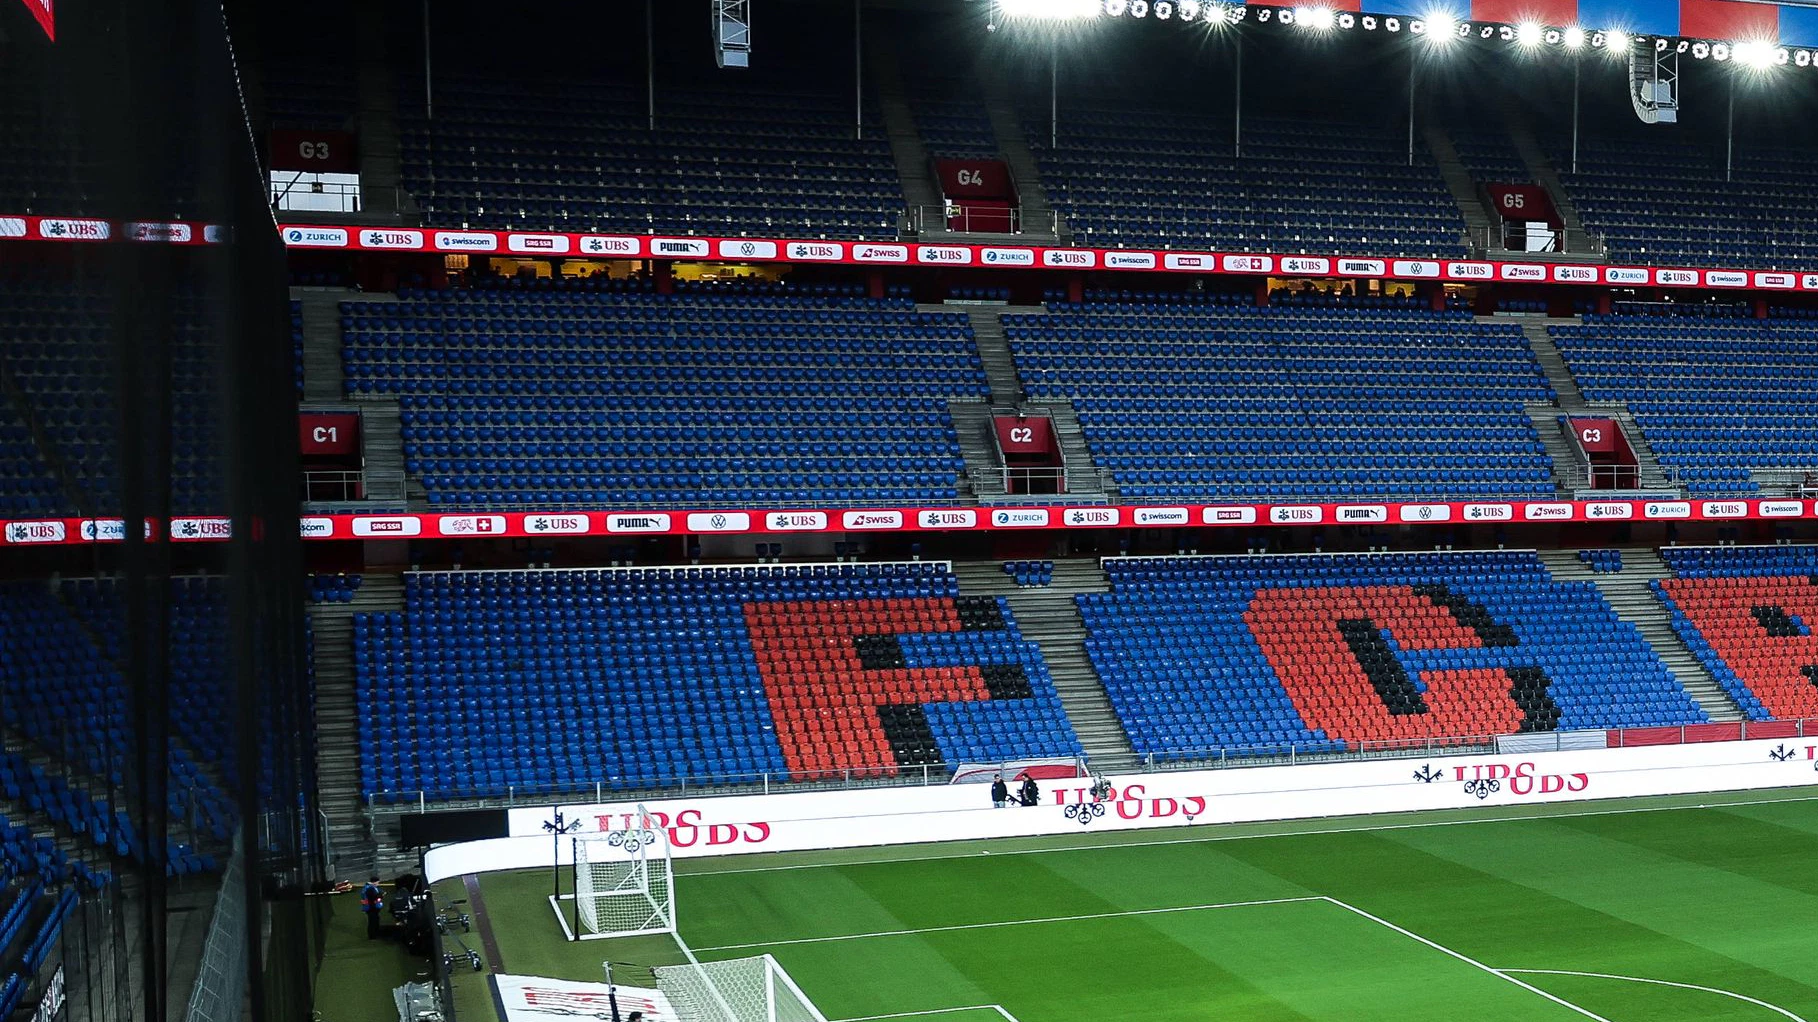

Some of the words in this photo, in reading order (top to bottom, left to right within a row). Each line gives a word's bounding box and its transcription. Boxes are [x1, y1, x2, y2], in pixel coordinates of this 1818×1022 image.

[299, 143, 329, 159] G3
[956, 168, 982, 186] G4
[1503, 193, 1524, 208] G5
[69, 224, 97, 235] UBS
[385, 234, 412, 244] UBS
[526, 239, 538, 247] SRG
[539, 239, 553, 247] SSR
[601, 241, 629, 250] UBS
[660, 242, 690, 252] PUMA
[807, 247, 832, 256] UBS
[873, 249, 900, 257] SWISS
[937, 251, 962, 259] UBS
[1062, 254, 1086, 263] UBS
[1298, 261, 1320, 270] UBS
[1346, 263, 1369, 271] PUMA
[1464, 266, 1485, 275] UBS
[1517, 268, 1539, 276] SWISS
[1569, 270, 1590, 278] UBS
[1671, 273, 1691, 281] UBS
[313, 426, 338, 443] C1
[1010, 428, 1032, 443] C2
[1582, 427, 1602, 443] C3
[1481, 508, 1503, 516] UBS
[1543, 507, 1566, 515] SWISS
[1605, 506, 1623, 515] UBS
[1721, 505, 1739, 513] UBS
[942, 514, 965, 523] UBS
[1087, 512, 1109, 521] UBS
[1292, 510, 1312, 519] UBS
[1345, 510, 1370, 518] PUMA
[547, 519, 577, 529] UBS
[617, 518, 649, 528] PUMA
[788, 516, 816, 526] UBS
[864, 515, 894, 525] SWISS
[200, 523, 230, 534] UBS
[372, 522, 386, 530] SRG
[387, 522, 401, 530] SSR
[30, 525, 54, 537] UBS
